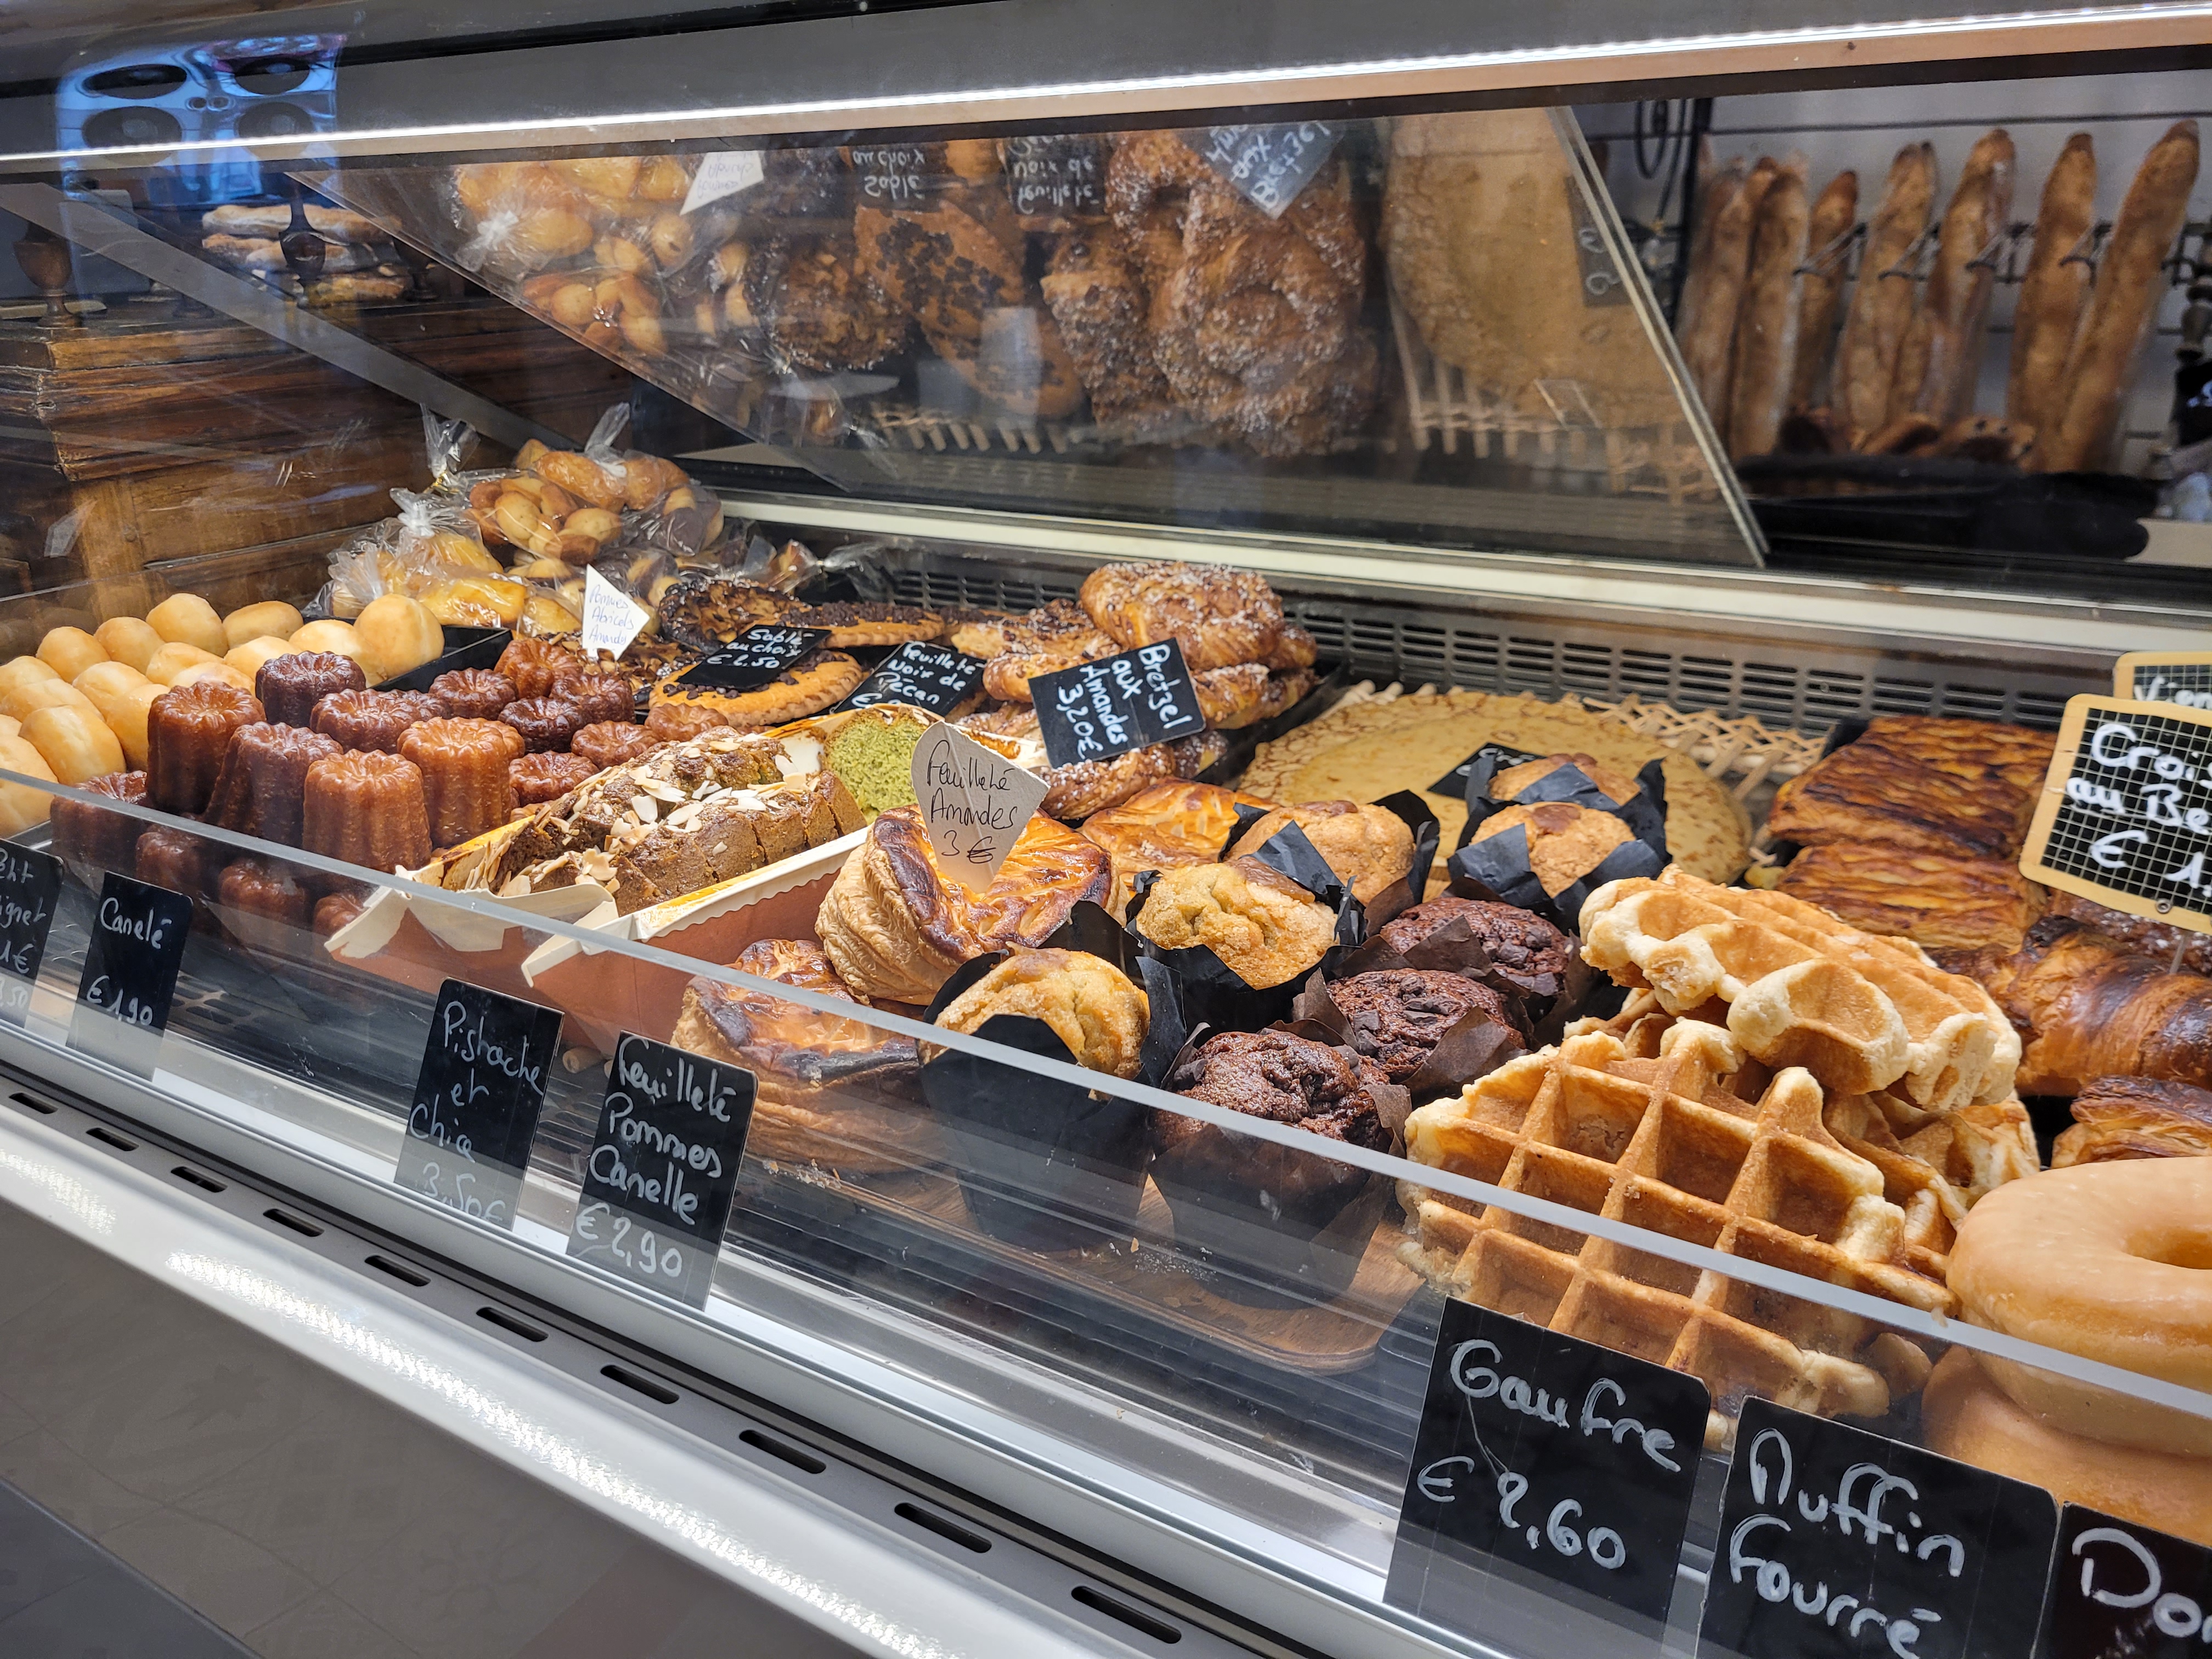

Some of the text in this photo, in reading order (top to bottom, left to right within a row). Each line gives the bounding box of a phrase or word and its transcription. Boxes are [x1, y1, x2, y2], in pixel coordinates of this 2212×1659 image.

[939, 672, 967, 692] de
[1079, 665, 1130, 745] Amandes
[100, 897, 173, 950] Canelé
[589, 1144, 699, 1226] Canelle
[1449, 1339, 1682, 1474] Gaufre
